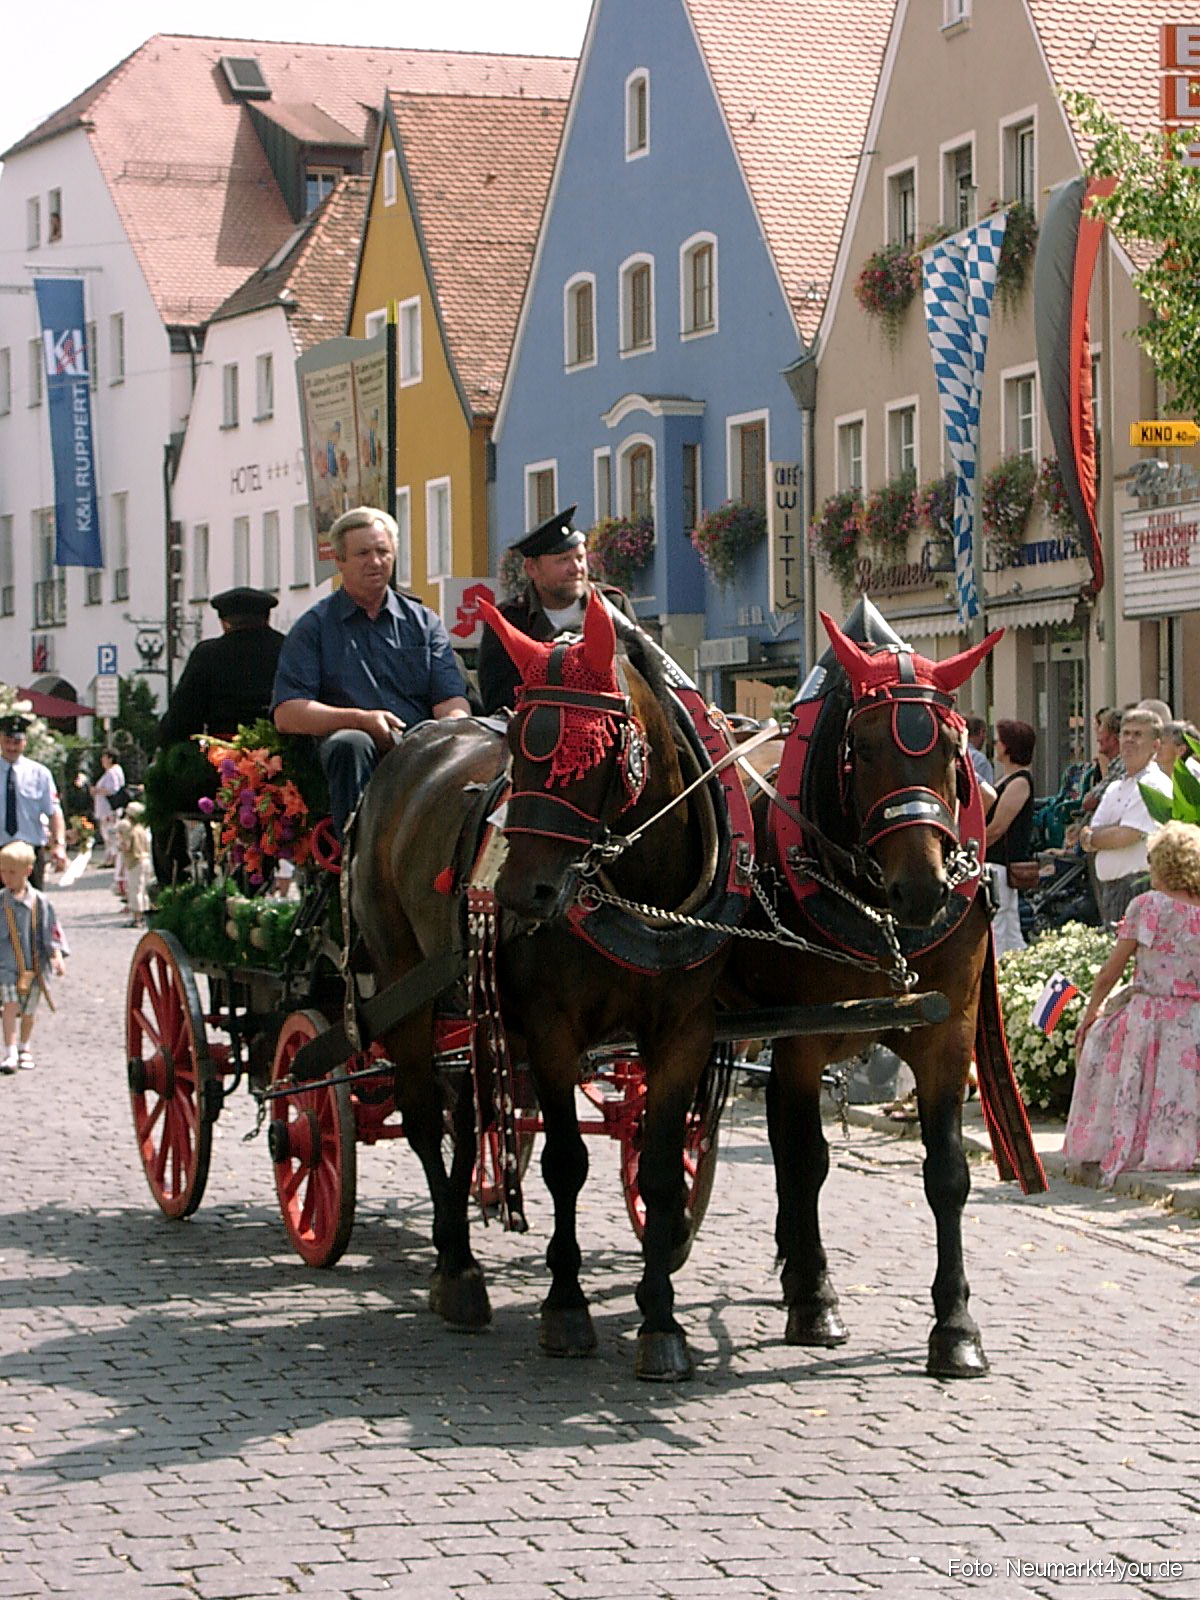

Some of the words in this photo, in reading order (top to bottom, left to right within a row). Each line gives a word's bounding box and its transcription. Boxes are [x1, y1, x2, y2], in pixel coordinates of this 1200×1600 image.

[72, 382, 92, 485] RUPPERT
[1141, 426, 1172, 442] KINO
[230, 464, 262, 495] HOTEL
[77, 491, 92, 531] K&L
[776, 491, 797, 598] WITTL
[1142, 546, 1190, 572] SURPRISE
[101, 648, 114, 673] P
